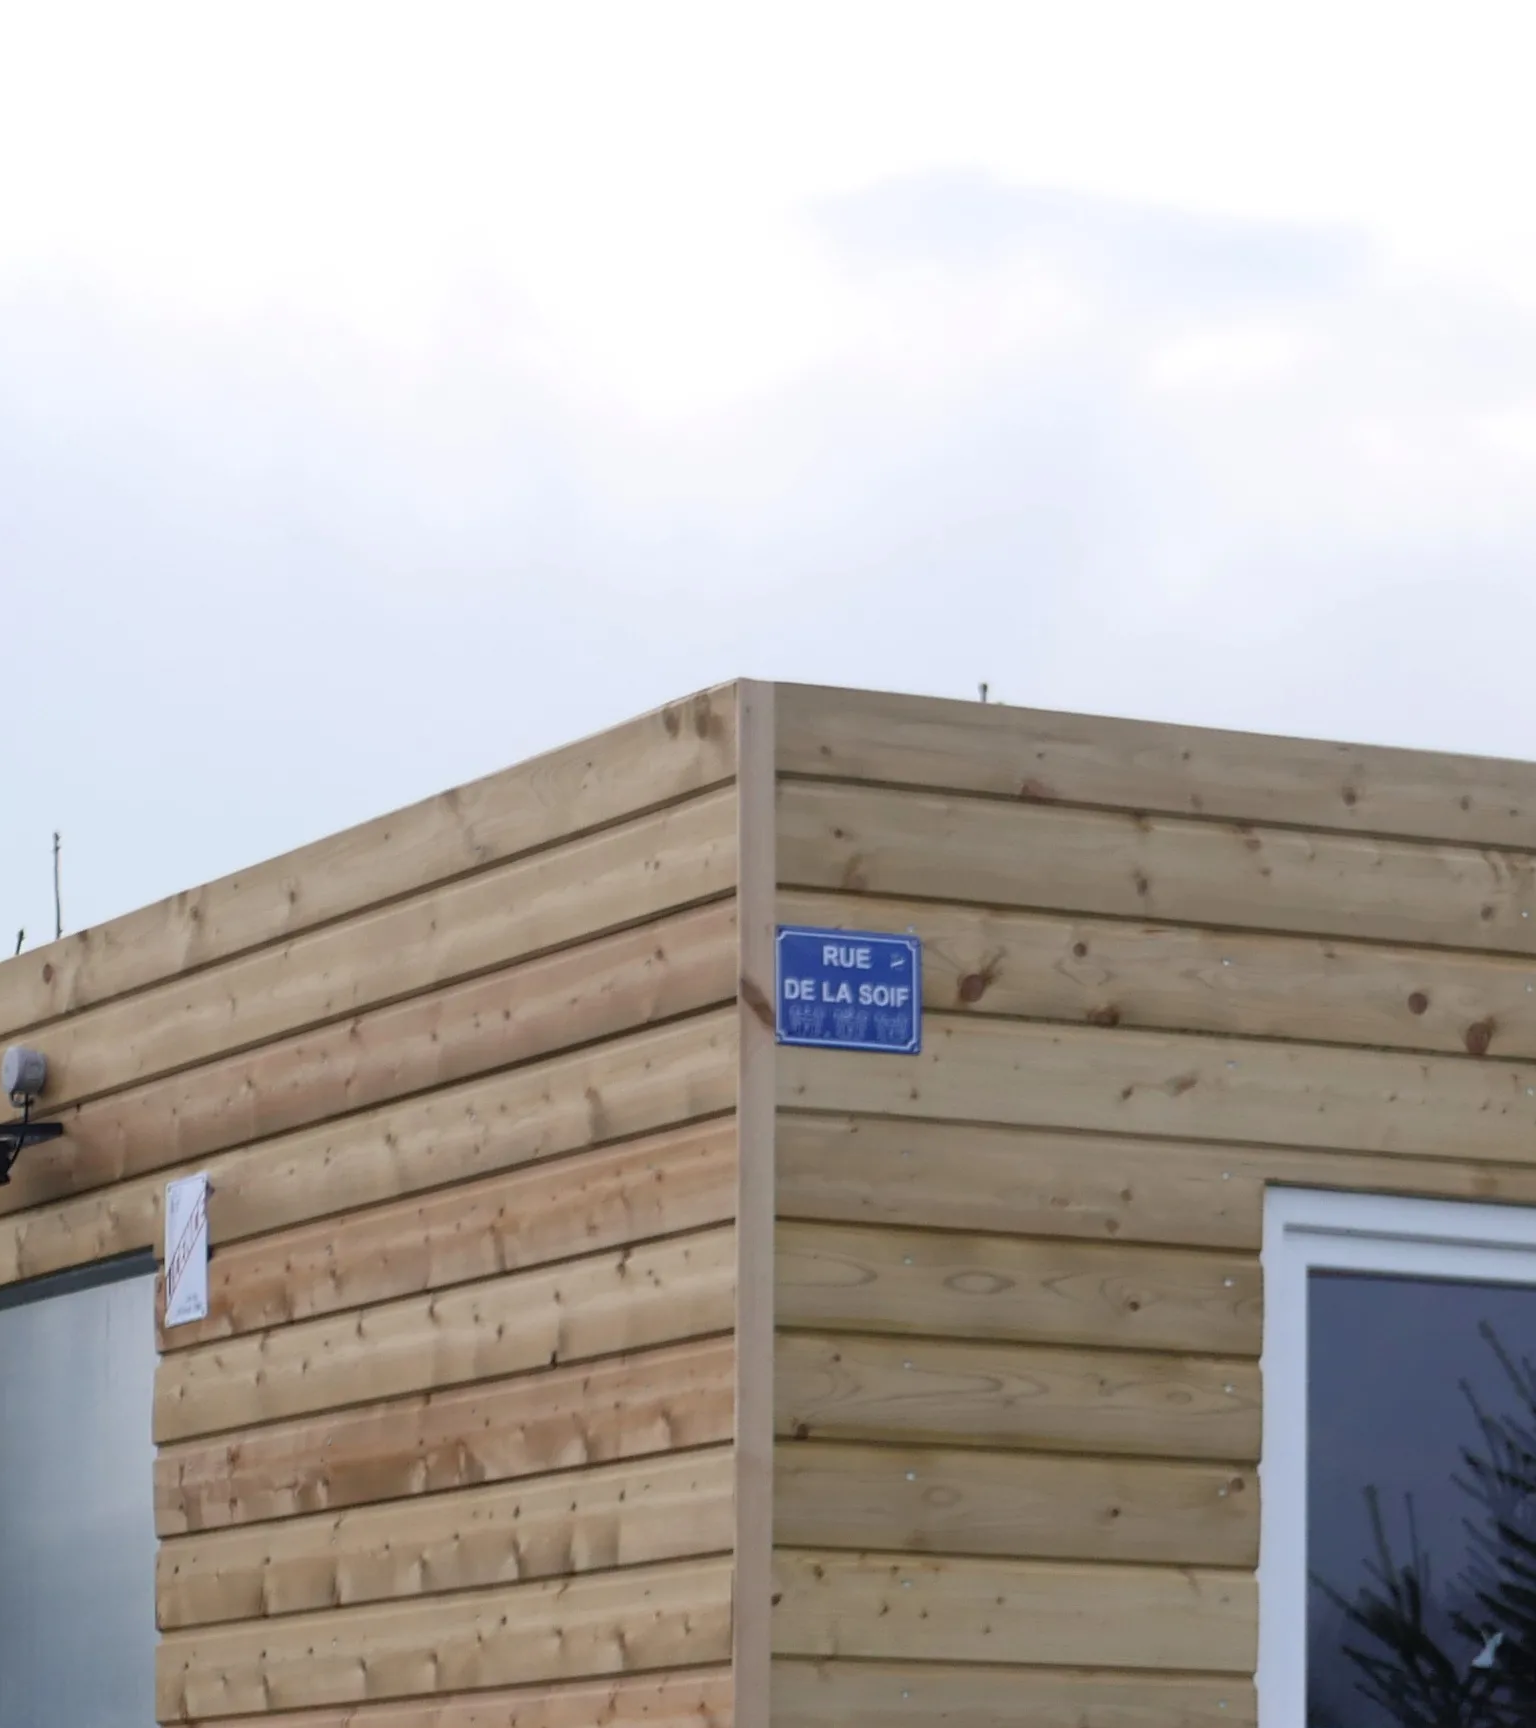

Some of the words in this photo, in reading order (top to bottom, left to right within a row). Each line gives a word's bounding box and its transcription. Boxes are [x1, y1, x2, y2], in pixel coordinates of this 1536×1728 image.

[821, 945, 873, 969] RUE
[783, 978, 816, 1001] DE
[821, 981, 853, 1004] LA
[858, 985, 910, 1008] SOIF
